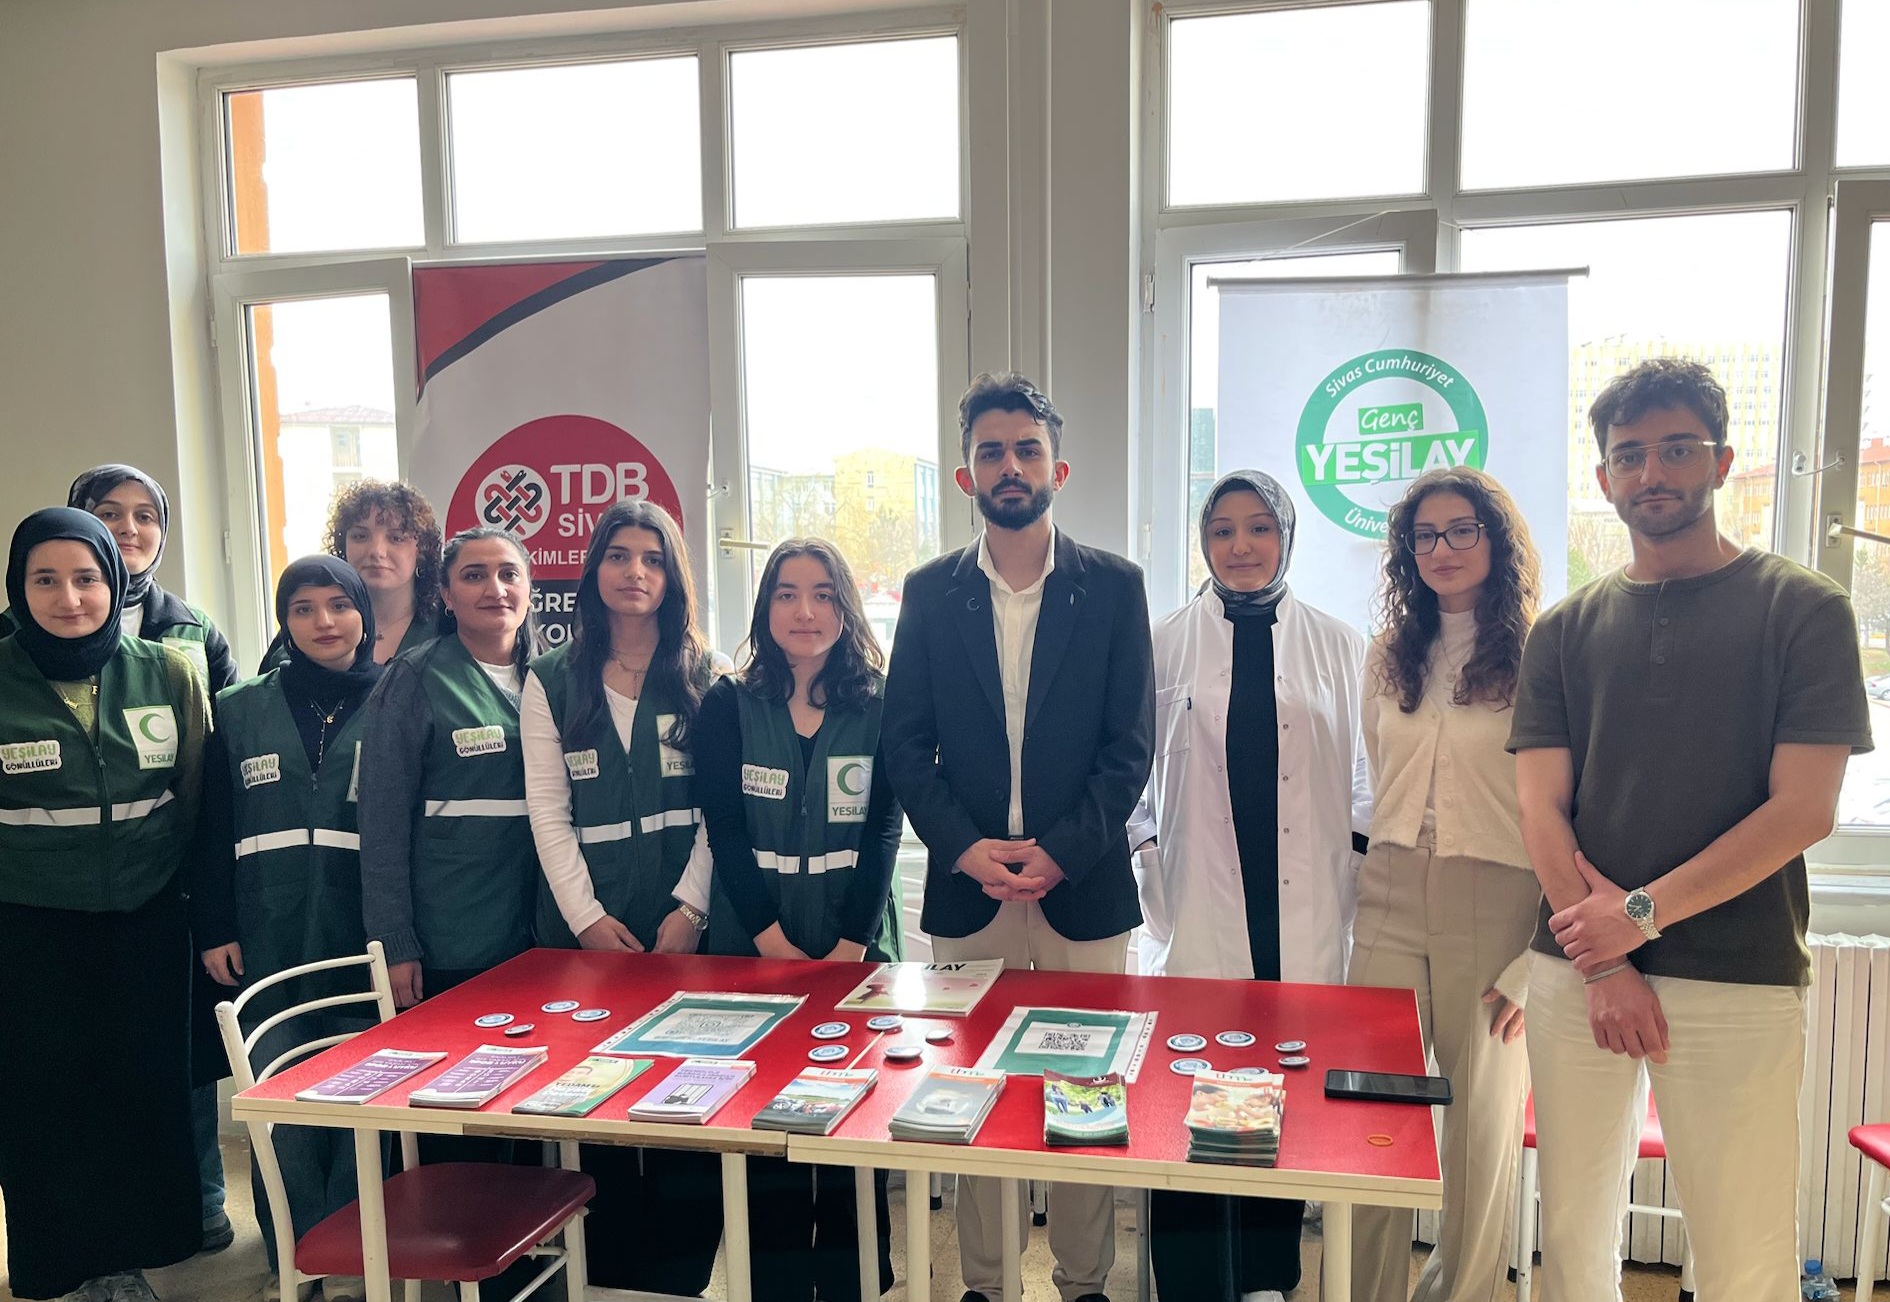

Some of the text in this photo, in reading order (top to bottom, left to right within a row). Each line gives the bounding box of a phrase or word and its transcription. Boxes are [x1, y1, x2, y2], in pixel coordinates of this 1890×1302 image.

[1326, 355, 1454, 397] Sivas Cumhuriyet
[1361, 409, 1419, 431] Genç
[550, 462, 649, 504] TDB
[1344, 507, 1389, 533] Ünive
